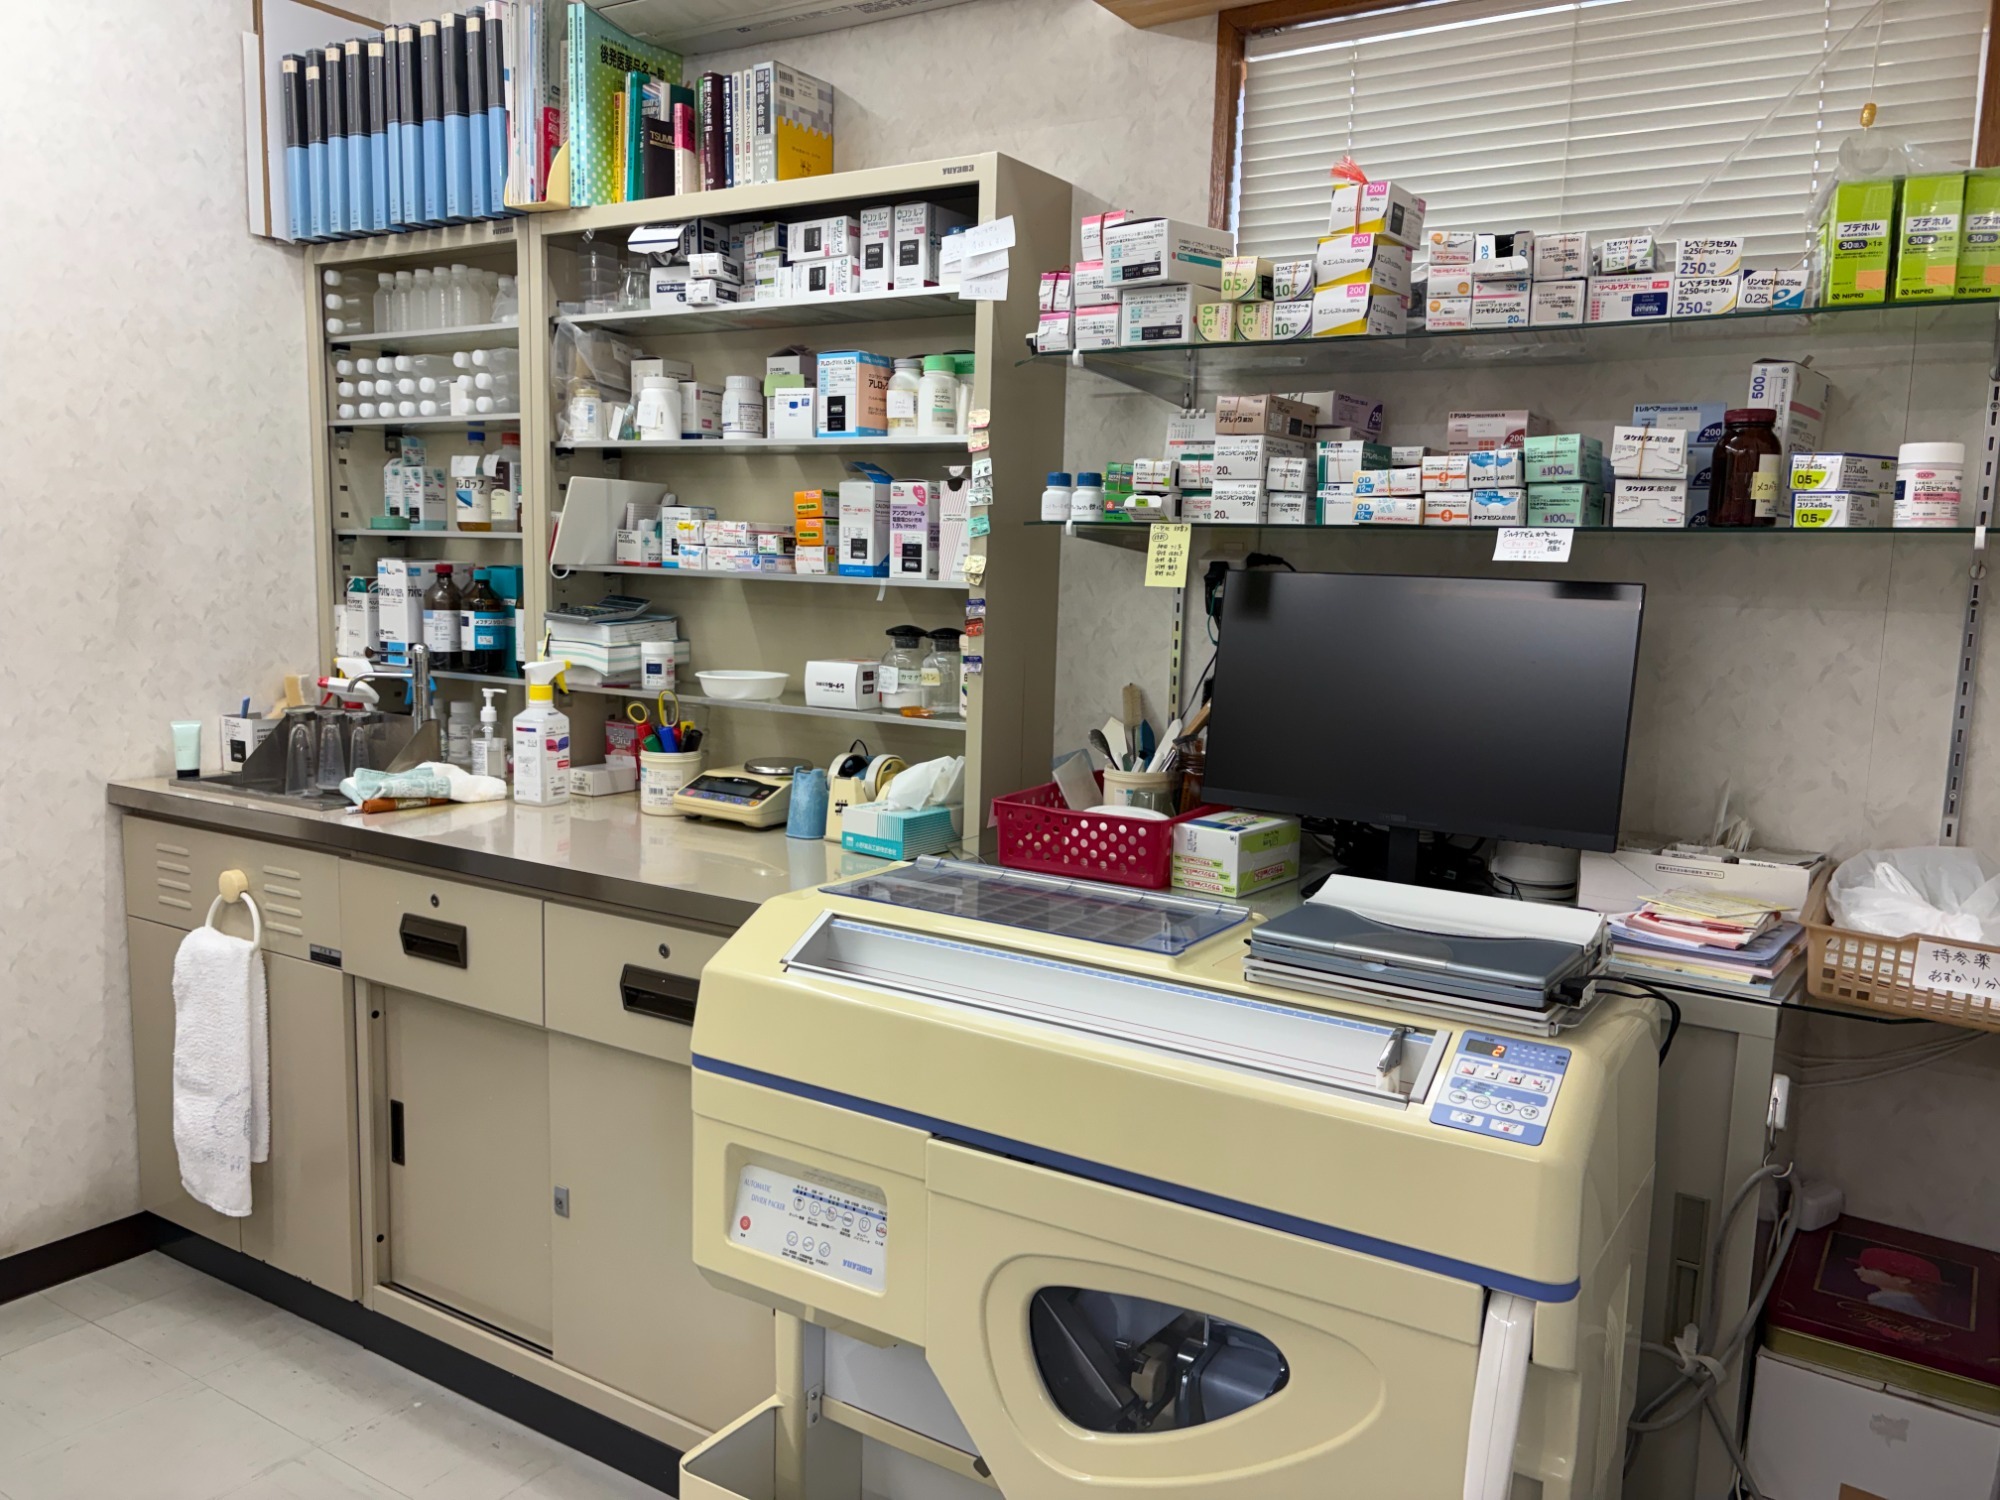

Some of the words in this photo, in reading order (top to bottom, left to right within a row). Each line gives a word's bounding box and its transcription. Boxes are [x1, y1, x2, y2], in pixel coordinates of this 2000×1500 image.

[942, 164, 974, 175] yuyama
[1369, 185, 1385, 193] 200
[1844, 222, 1880, 232] ブデホル
[1913, 218, 1951, 227] ブデホル
[1353, 236, 1368, 244] 200
[1680, 263, 1714, 274] 250mg
[1680, 280, 1732, 288] レベチラセタム
[1349, 286, 1364, 294] 200
[1677, 302, 1711, 314] 250mg
[1508, 316, 1525, 324] 20mg
[1548, 466, 1573, 475] 100mg
[1550, 514, 1574, 523] 100mg
[1801, 513, 1825, 523] 0.5mg
[1932, 948, 1990, 970] 持参薬
[1492, 1046, 1505, 1057] 2
[843, 1259, 872, 1275] yuyama
